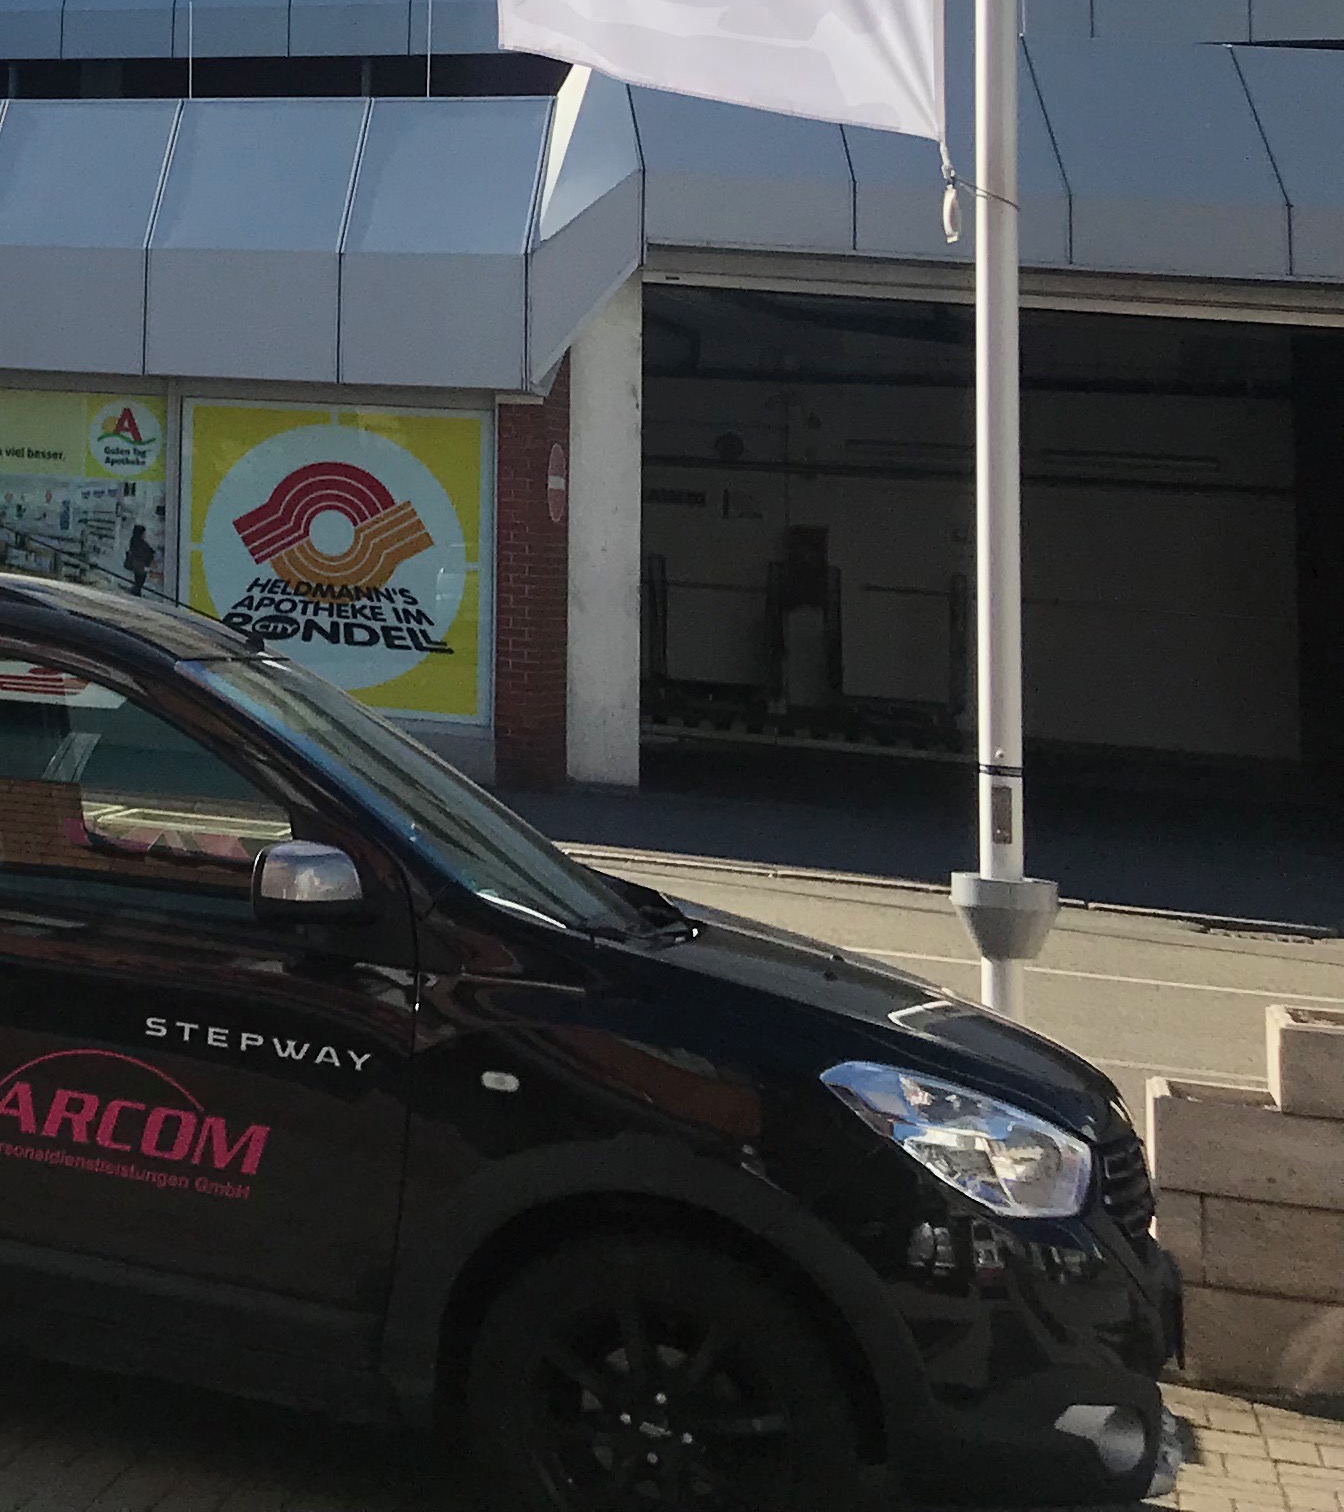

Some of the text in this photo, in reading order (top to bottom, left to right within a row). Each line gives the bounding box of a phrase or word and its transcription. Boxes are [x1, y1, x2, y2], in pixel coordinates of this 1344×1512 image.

[5, 446, 25, 459] viel
[27, 448, 66, 461] besser.
[246, 577, 419, 606] HELDMANN'S
[231, 595, 434, 627] APOTHEKE IM
[145, 1016, 373, 1072] STEPWAY
[194, 1175, 251, 1200] GmbH
